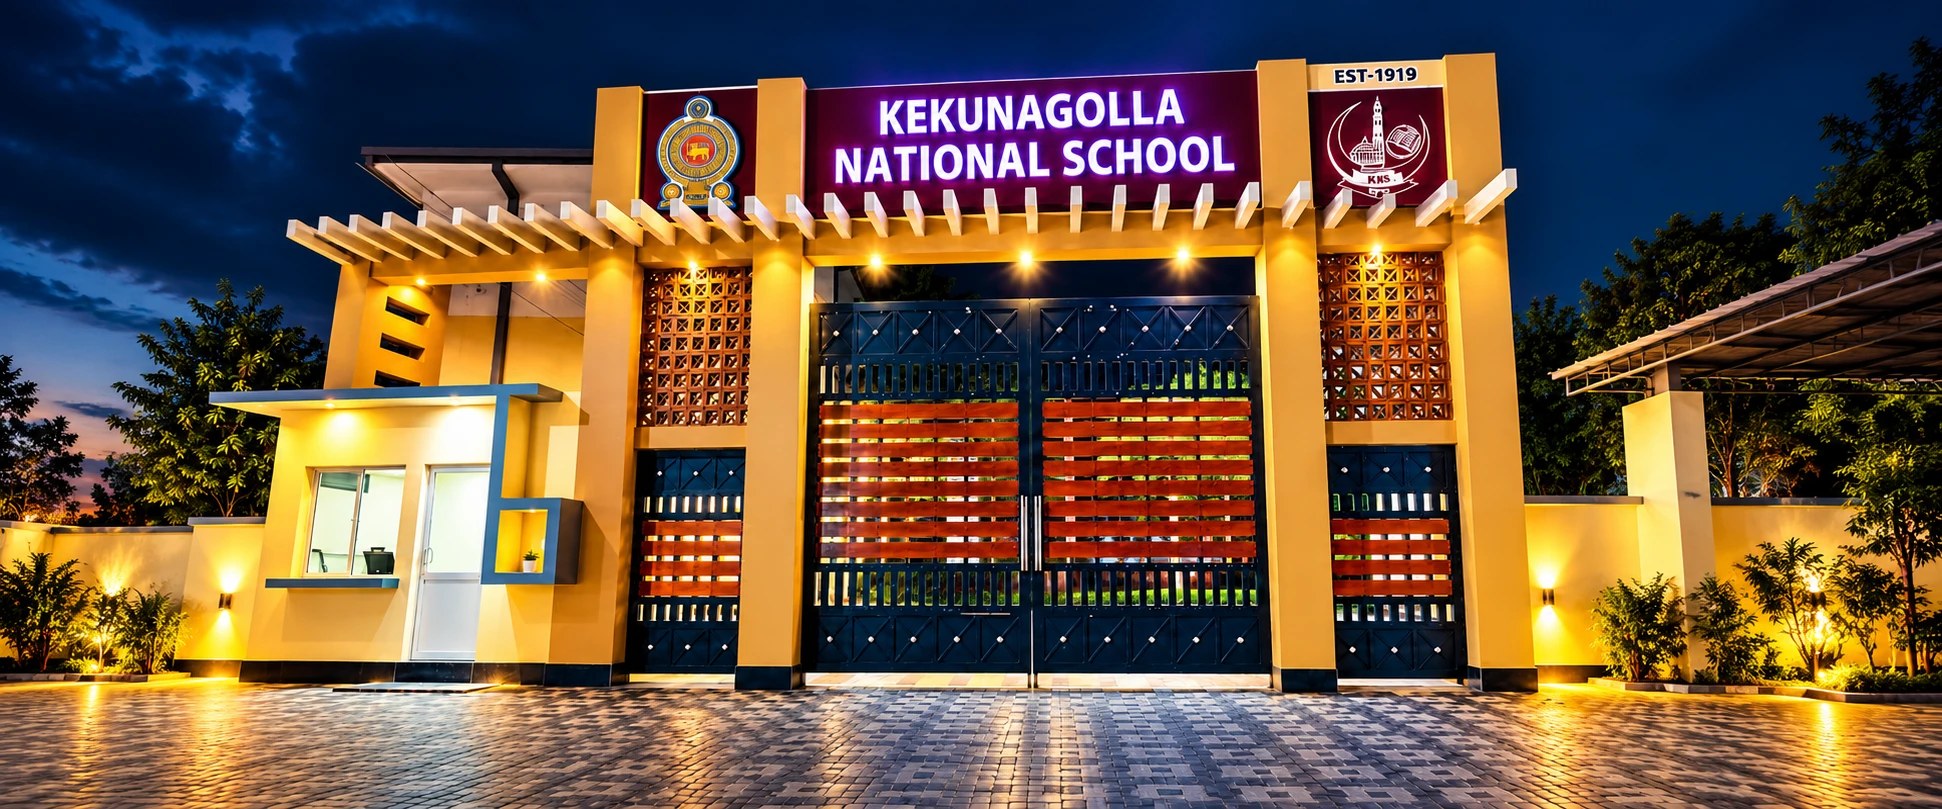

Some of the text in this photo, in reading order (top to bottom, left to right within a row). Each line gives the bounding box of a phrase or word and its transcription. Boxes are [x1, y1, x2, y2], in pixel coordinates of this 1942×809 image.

[1334, 67, 1417, 84] EST-1919
[878, 88, 1185, 136] KEKUNAGOLLA
[835, 135, 1235, 184] NATIONAL SCHOOL
[1367, 174, 1391, 185] KNS
